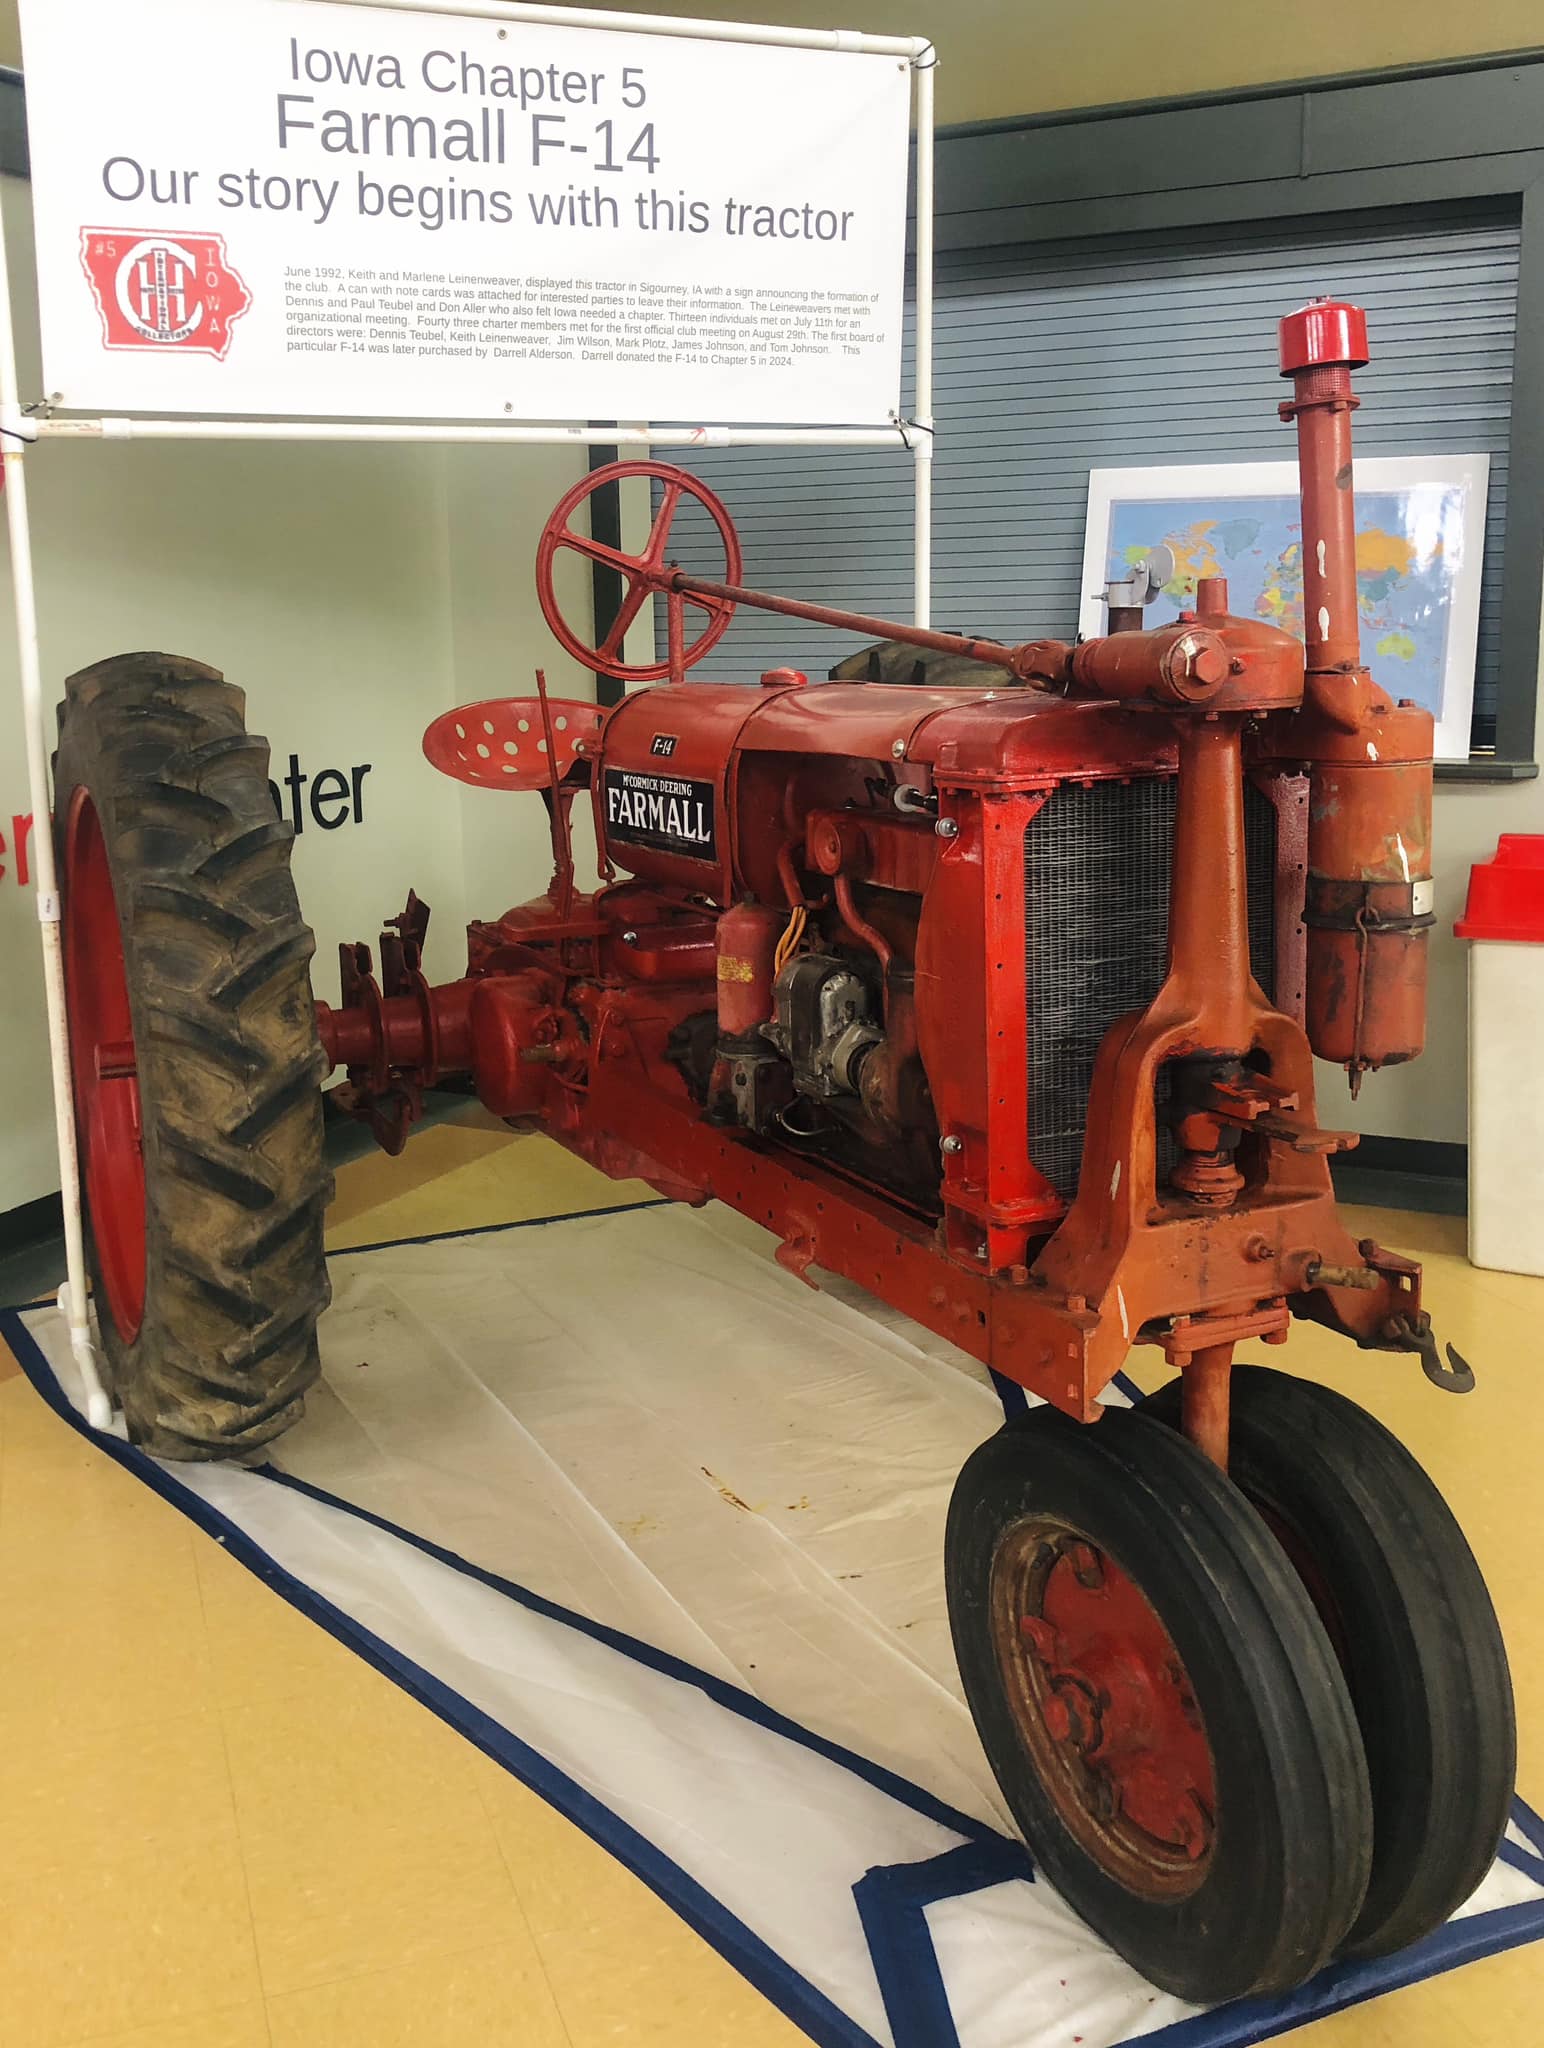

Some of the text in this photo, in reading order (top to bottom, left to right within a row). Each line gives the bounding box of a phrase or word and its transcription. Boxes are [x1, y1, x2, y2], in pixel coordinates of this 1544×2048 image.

[290, 37, 647, 111] Iowa Chapter 5
[276, 92, 661, 175] Farmall F-14
[101, 156, 855, 242] Our story begins with this tractor
[94, 240, 117, 259] #5
[283, 266, 311, 277] June
[347, 269, 376, 281] Keith
[378, 271, 399, 281] and
[402, 271, 446, 283] Marlene
[524, 276, 573, 291] displayed
[574, 279, 593, 290] this
[594, 281, 627, 292] tractor
[627, 283, 637, 292] in
[691, 285, 703, 295] IA
[703, 285, 723, 296] with
[724, 288, 732, 297] a
[733, 288, 754, 299] sign
[755, 289, 809, 302] announcing
[810, 290, 825, 301] the
[826, 291, 869, 303] formation
[869, 293, 879, 303] of
[284, 280, 302, 292] the
[337, 283, 346, 294] A
[347, 285, 368, 294] can
[370, 284, 393, 296] with
[395, 287, 420, 297] note
[421, 287, 452, 298] cards
[453, 290, 476, 299] was
[477, 289, 522, 301] attached
[523, 290, 538, 302] for
[539, 292, 589, 304] interested
[590, 295, 624, 307] parties
[625, 297, 636, 306] to
[637, 294, 664, 308] leave
[665, 297, 688, 308] their
[689, 298, 745, 311] information.
[749, 301, 768, 312] The
[769, 300, 832, 314] Leineweavers
[833, 306, 851, 315] met
[852, 306, 871, 316] with
[285, 295, 861, 329] Dennis and Paul Teubel and Don Aller who also felt Iowa needed a chapter. Thirteen individuals met on July 11th for an
[285, 312, 363, 324] organizational
[364, 314, 410, 328] meeting.
[416, 315, 451, 330] Fourty
[452, 316, 480, 328] three
[481, 318, 519, 330] charter
[519, 320, 567, 332] members
[568, 323, 589, 333] met
[590, 322, 604, 333] for
[605, 322, 622, 334] the
[623, 323, 642, 335] first
[643, 324, 675, 336] official
[676, 325, 697, 337] club
[698, 328, 737, 340] meeting
[737, 329, 751, 338] on
[751, 329, 785, 341] August
[810, 330, 829, 341] The
[830, 331, 848, 342] first
[848, 332, 875, 343] board
[875, 333, 885, 343] of
[285, 325, 334, 337] directors
[335, 329, 367, 338] were:
[369, 328, 407, 340] Dennis
[408, 329, 447, 343] Teubel,
[449, 331, 477, 343] Keith
[556, 335, 575, 346] Jim
[576, 336, 613, 348] Wilson,
[615, 337, 640, 348] Mark
[671, 339, 703, 351] James
[704, 340, 747, 353] Johnson,
[749, 342, 767, 353] and
[769, 342, 789, 353] Tom
[841, 345, 861, 356] This
[286, 341, 794, 367] particular F-14 was later purchased by Darrell Alderson. Darrell donated the F-14 to Chapter 5 in 2024.
[653, 738, 673, 755] F-14
[659, 779, 693, 797] DEERING
[607, 787, 712, 842] FARMALL
